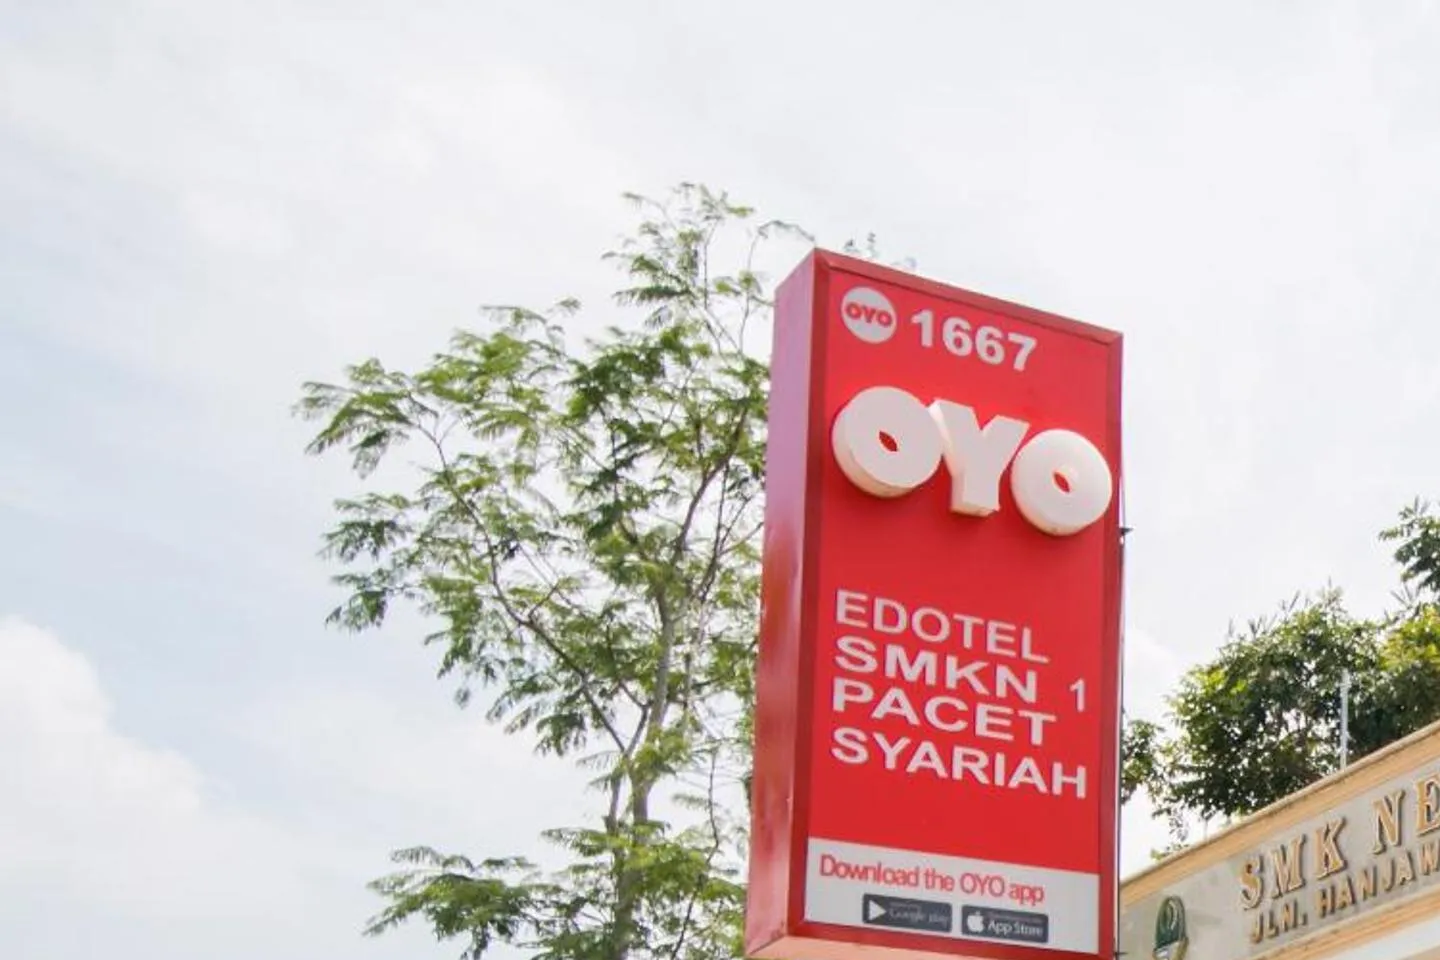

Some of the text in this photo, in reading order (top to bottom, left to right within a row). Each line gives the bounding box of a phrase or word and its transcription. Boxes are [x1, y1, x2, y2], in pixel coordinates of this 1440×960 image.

[845, 301, 1037, 371] OYO 1667
[831, 385, 1113, 536] OYO
[835, 588, 1051, 664] EDOTEL
[834, 635, 1087, 713] SMKN 1
[832, 677, 1057, 747] PACET
[831, 727, 1089, 799] SYARIAH
[820, 854, 1045, 906] Download the OYO app
[1239, 816, 1347, 911] SMK
[988, 919, 1013, 935] App
[1251, 901, 1309, 944] JLN.
